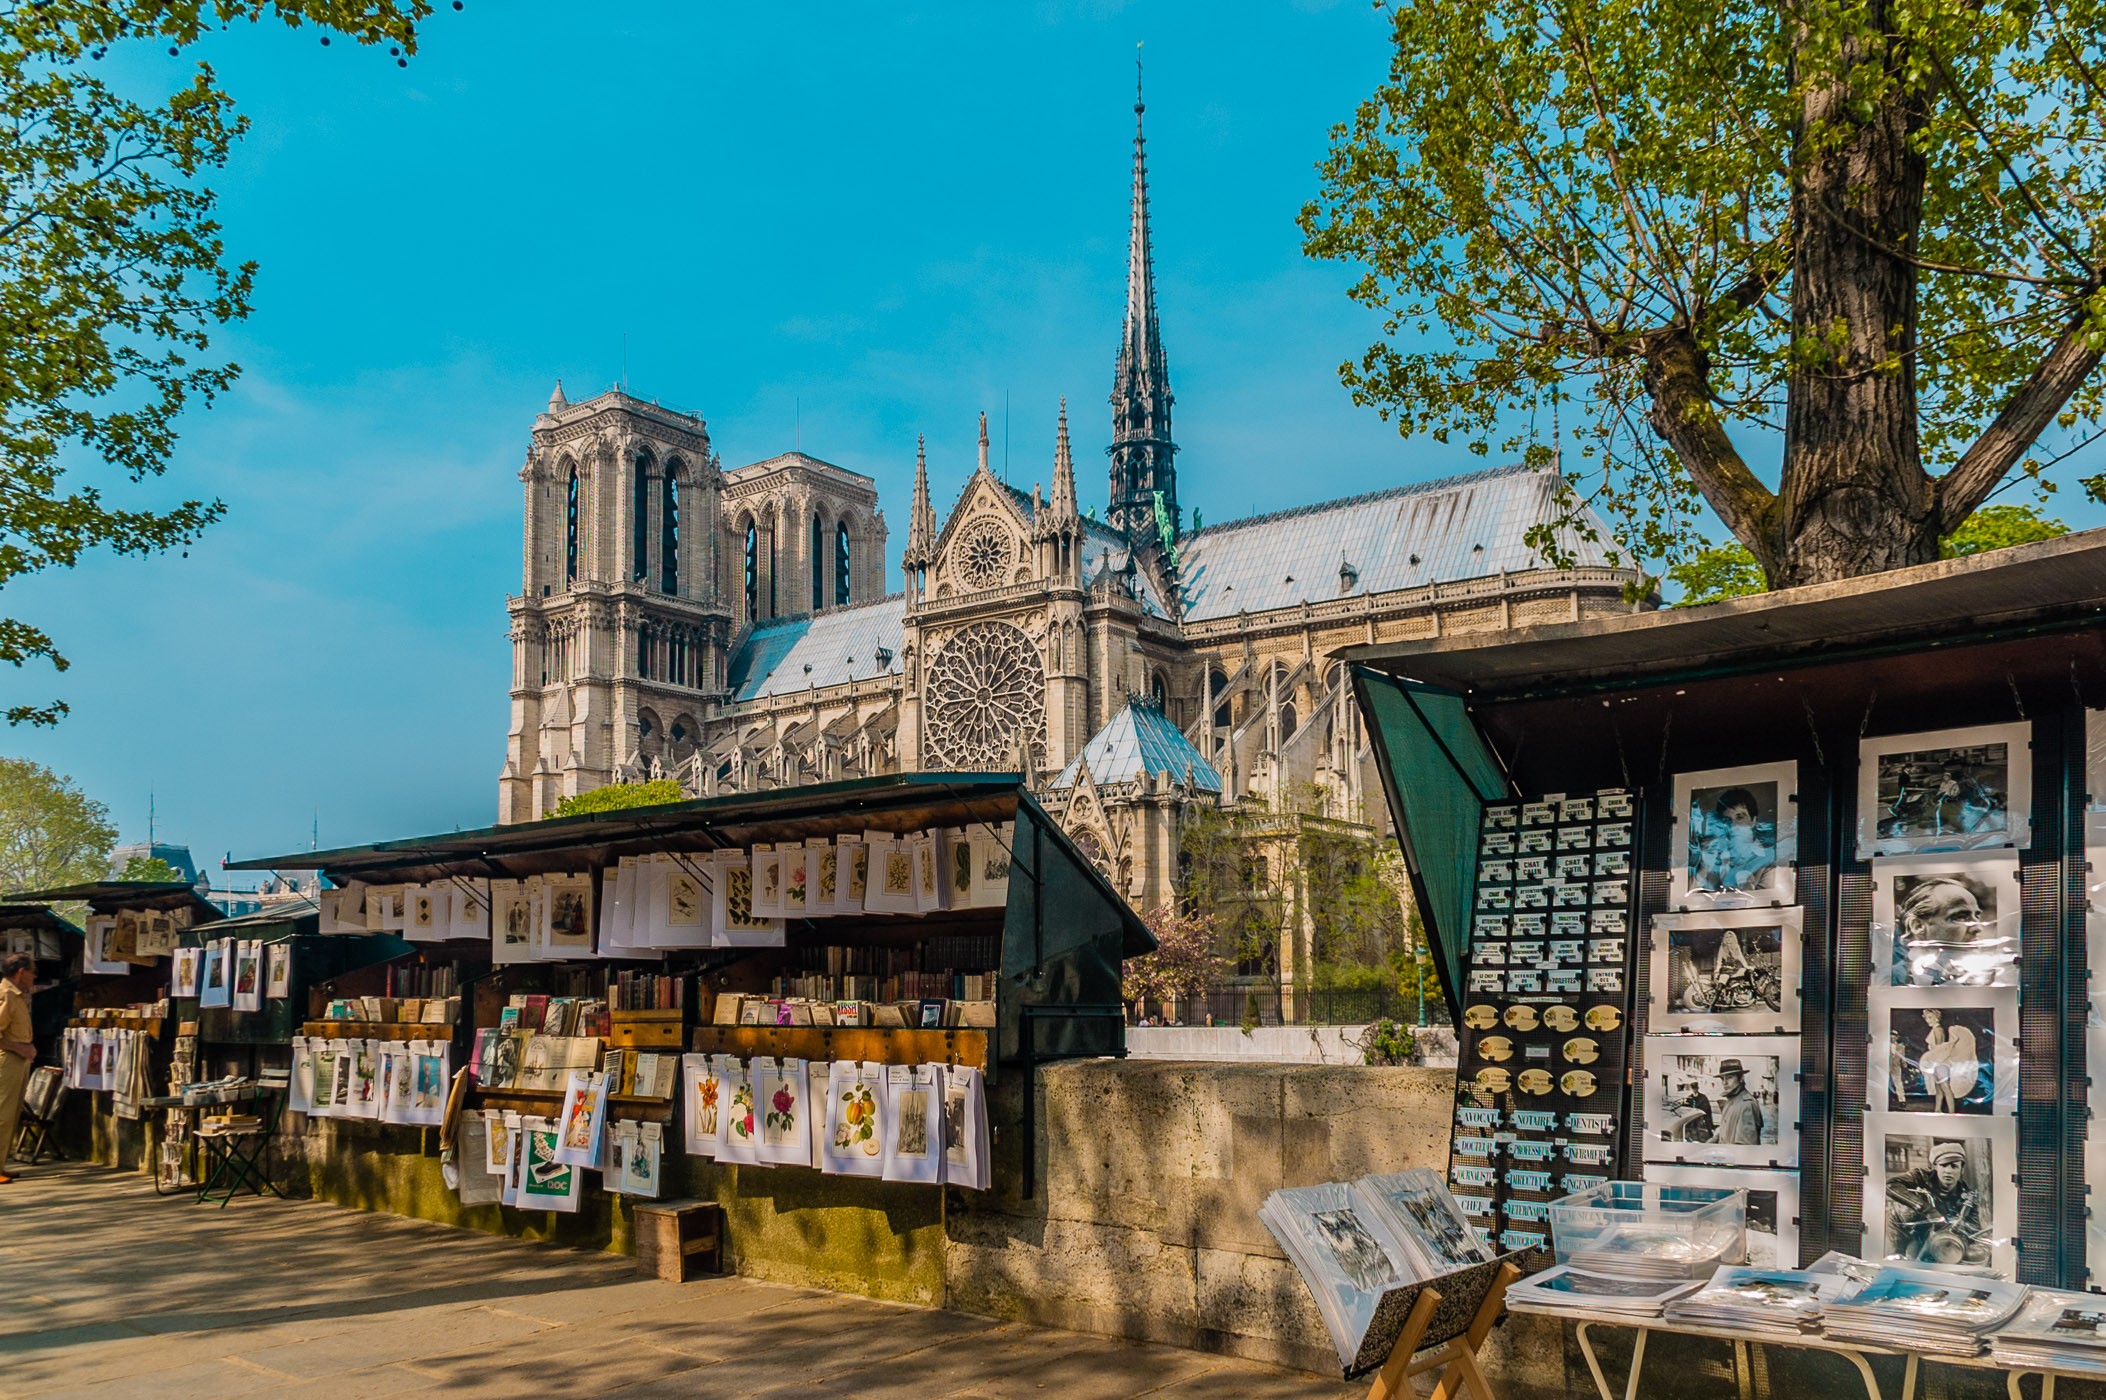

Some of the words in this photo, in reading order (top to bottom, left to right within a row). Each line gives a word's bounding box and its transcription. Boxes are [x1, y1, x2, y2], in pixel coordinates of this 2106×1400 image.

[1567, 802, 1586, 810] CHIEN
[1523, 860, 1540, 868] CHAT
[1564, 858, 1581, 867] CHAT
[1562, 865, 1583, 874] GENTIL
[1551, 977, 1577, 985] TOILETTES
[1465, 1112, 1497, 1122] AVOCAT
[1517, 1114, 1552, 1127] NOTAIRE
[1461, 1140, 1493, 1153] DOCTEUR
[1461, 1200, 1483, 1212] CHEF
